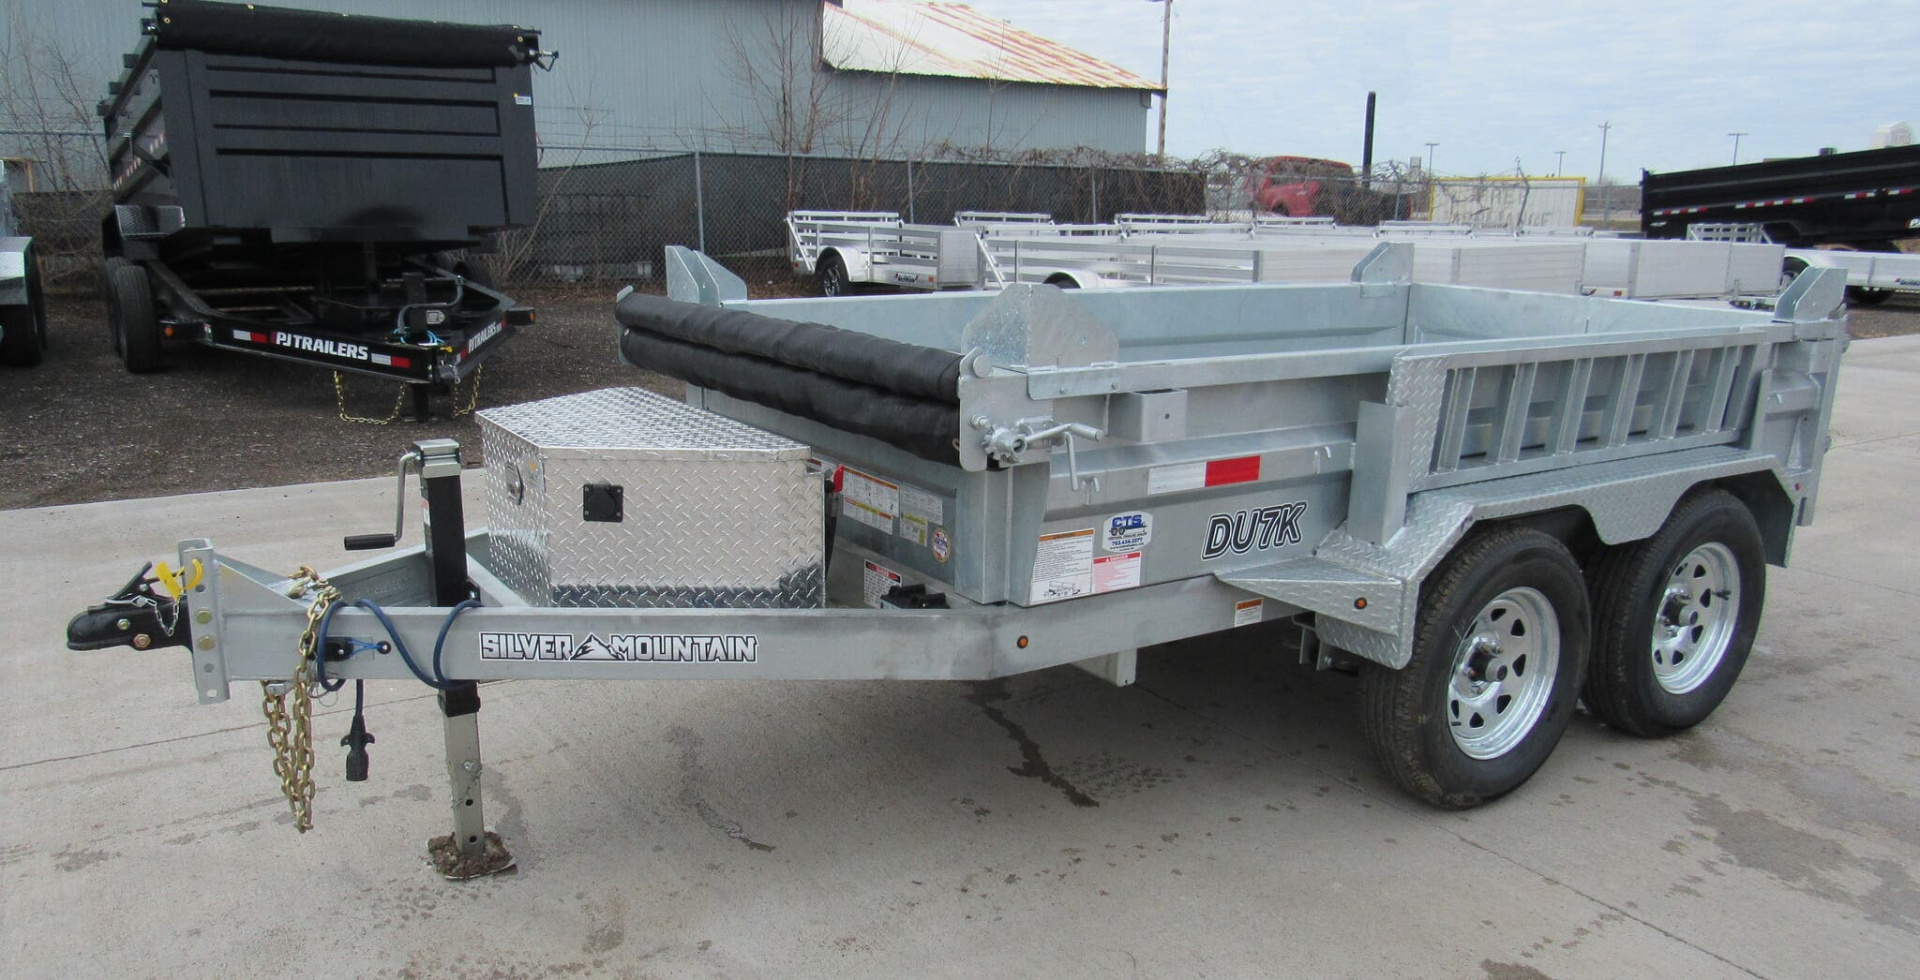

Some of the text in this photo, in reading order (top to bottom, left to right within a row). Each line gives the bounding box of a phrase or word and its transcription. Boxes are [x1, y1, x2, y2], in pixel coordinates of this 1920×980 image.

[275, 331, 369, 361] PJ TRAILERS
[1112, 514, 1142, 528] CTS
[1201, 501, 1307, 560] DU7K
[480, 632, 758, 662] SILVER MOUNTAIN
